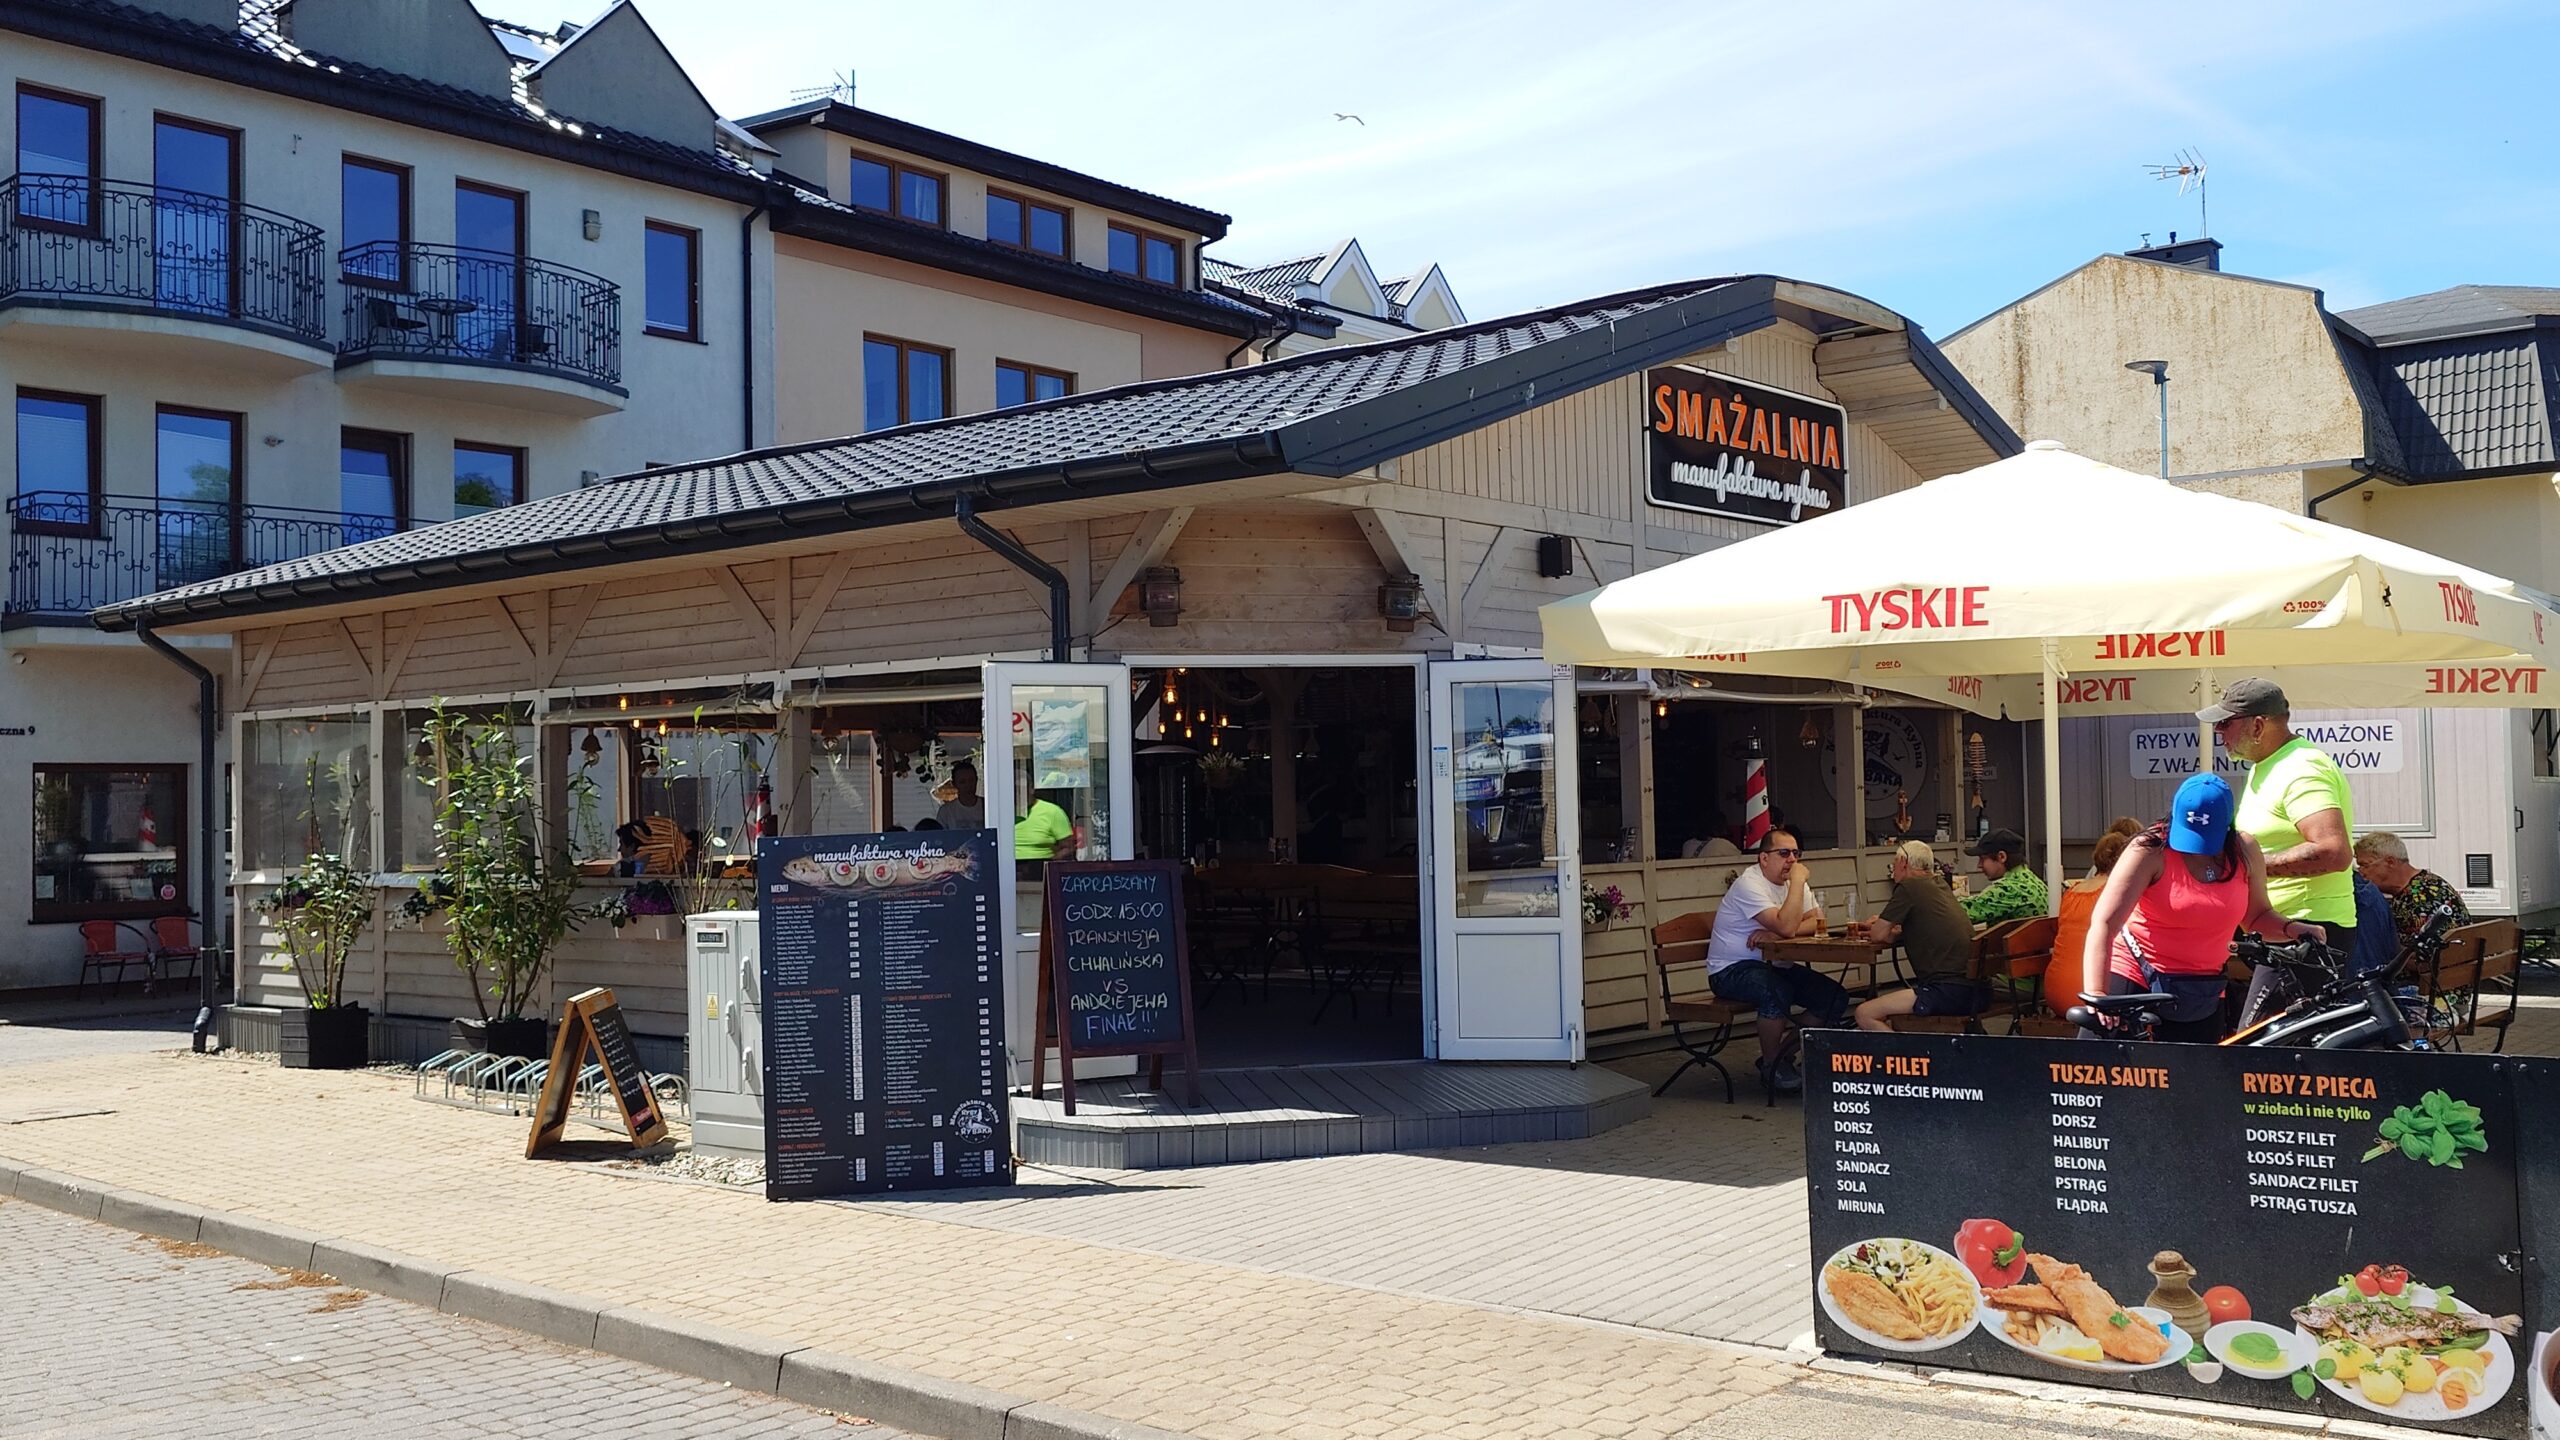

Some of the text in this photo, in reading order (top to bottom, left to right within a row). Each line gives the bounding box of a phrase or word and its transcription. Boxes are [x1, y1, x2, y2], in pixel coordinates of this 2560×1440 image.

[1655, 384, 1840, 470] SMAŻALNIA
[1671, 452, 1831, 521] manufaktura rybna
[1822, 586, 1990, 633] TYSKIE
[2297, 601, 2327, 609] 100%
[2438, 582, 2479, 626] TYSKIE
[28, 726, 36, 735] 9
[2137, 733, 2180, 749] RYBY
[2295, 724, 2394, 743] SMAŻONE
[2149, 759, 2160, 774] Z
[813, 841, 945, 865] manufaktura rybna
[770, 884, 789, 893] MENU
[1061, 875, 1156, 893] ZAPRASZAMY
[1119, 902, 1164, 920] 15:00
[1068, 928, 1160, 949] TRANSMISJA
[1068, 951, 1164, 971] CHWALIŃSKA
[1831, 1053, 1873, 1074] RYBY
[1886, 1056, 1930, 1076] FILET
[2049, 1063, 2170, 1089] TUSZA SAUTE
[1832, 1082, 1984, 1101] DORSZ W CIEŚCIE PIWNYM
[2243, 1073, 2377, 1099] RYBY Z PIECA
[1833, 1100, 1870, 1115] ŁOSOŚ
[2051, 1093, 2103, 1108] TURBOT
[2244, 1101, 2371, 1122] w ziołach i nie tylko
[1834, 1121, 1873, 1134] DORSZ
[2052, 1114, 2097, 1128] DORSZ
[2053, 1135, 2110, 1150] HALIBUT
[2246, 1128, 2336, 1146] DORSZ FILET
[1835, 1140, 1881, 1156] FLĄDRA
[1836, 1160, 1891, 1175] SANDACZ
[2054, 1156, 2107, 1171] BELONA
[2247, 1150, 2336, 1169] ŁOSOŚ FILET
[1837, 1180, 1867, 1193] SOLA
[2055, 1176, 2107, 1195] PSTRĄG
[2248, 1173, 2359, 1193] SANDACZ FILET
[1838, 1199, 1885, 1214] MIRUNA
[2056, 1198, 2109, 1215] FLĄDRA
[2250, 1194, 2357, 1215] PSTRĄG TUSZA
